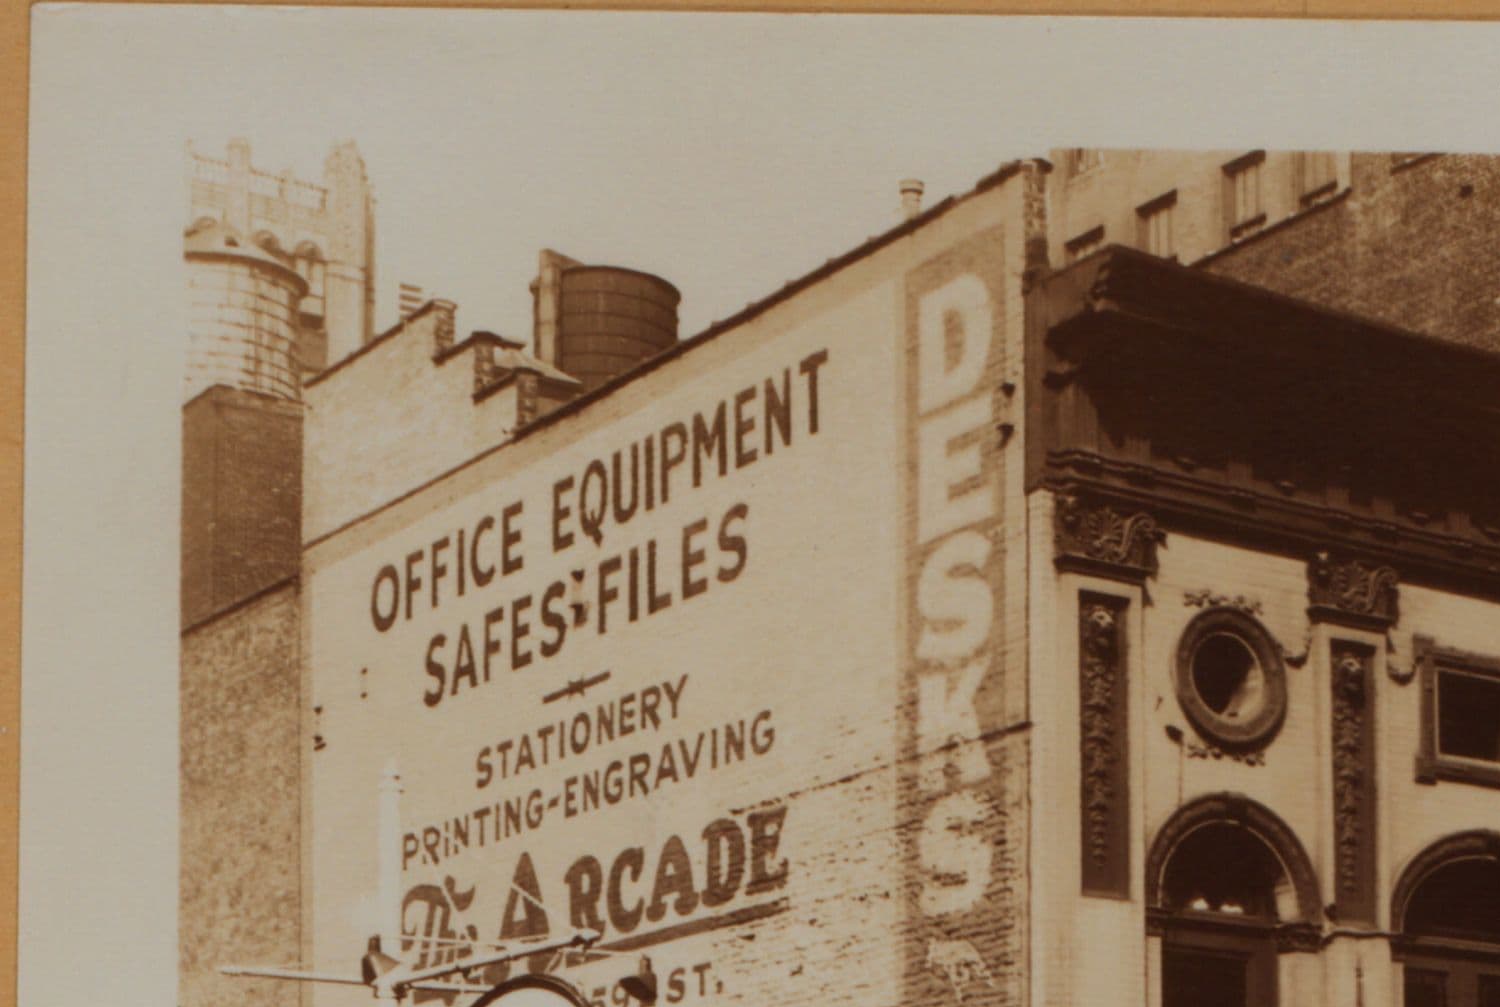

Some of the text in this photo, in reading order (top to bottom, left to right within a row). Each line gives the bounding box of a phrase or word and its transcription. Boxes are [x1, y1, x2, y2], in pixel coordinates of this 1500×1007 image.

[370, 349, 829, 632] OFFICE EQUIPMENT
[422, 503, 750, 708] SAFES FILES
[911, 272, 997, 915] DESKS
[402, 709, 777, 871] PRINTING-ENGRAVING
[475, 675, 689, 790] STATIONERY
[500, 805, 789, 941] ARCADE
